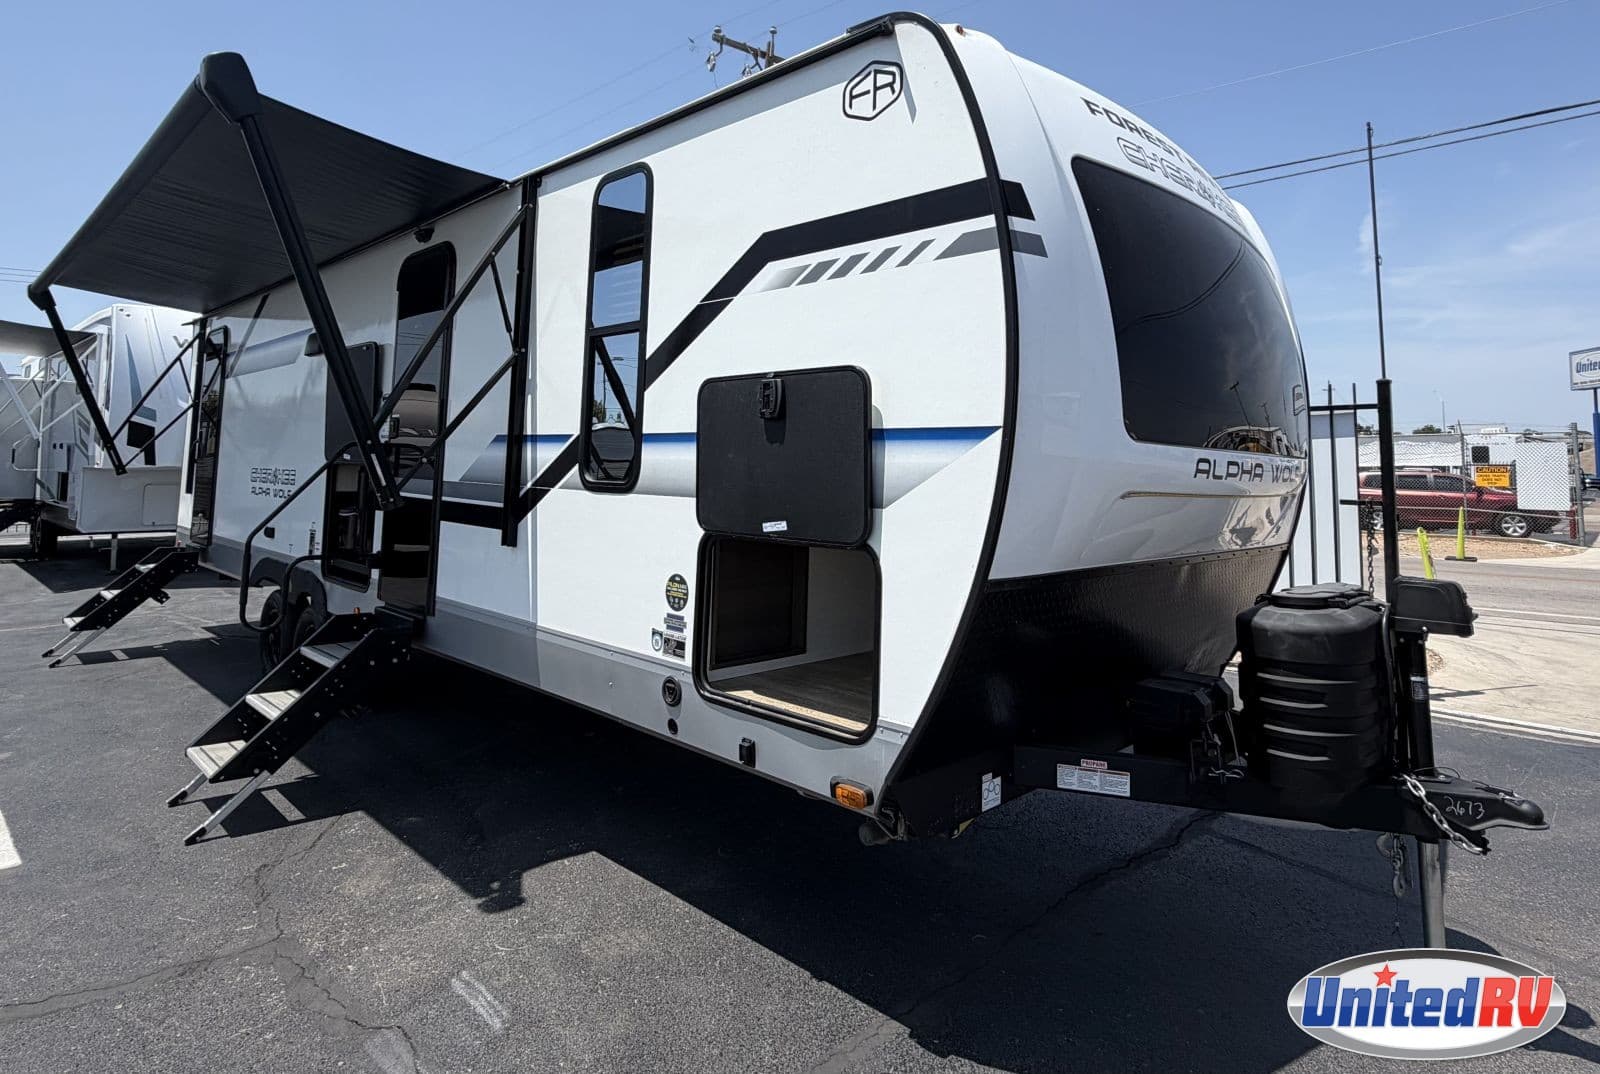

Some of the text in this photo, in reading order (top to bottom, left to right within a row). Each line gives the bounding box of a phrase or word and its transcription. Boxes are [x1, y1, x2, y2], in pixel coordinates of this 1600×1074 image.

[849, 69, 896, 111] FR
[1080, 97, 1184, 162] FOREST
[1117, 136, 1243, 227] CHER
[251, 486, 271, 497] ALPHA
[1193, 458, 1301, 484] ALPHA WOLF
